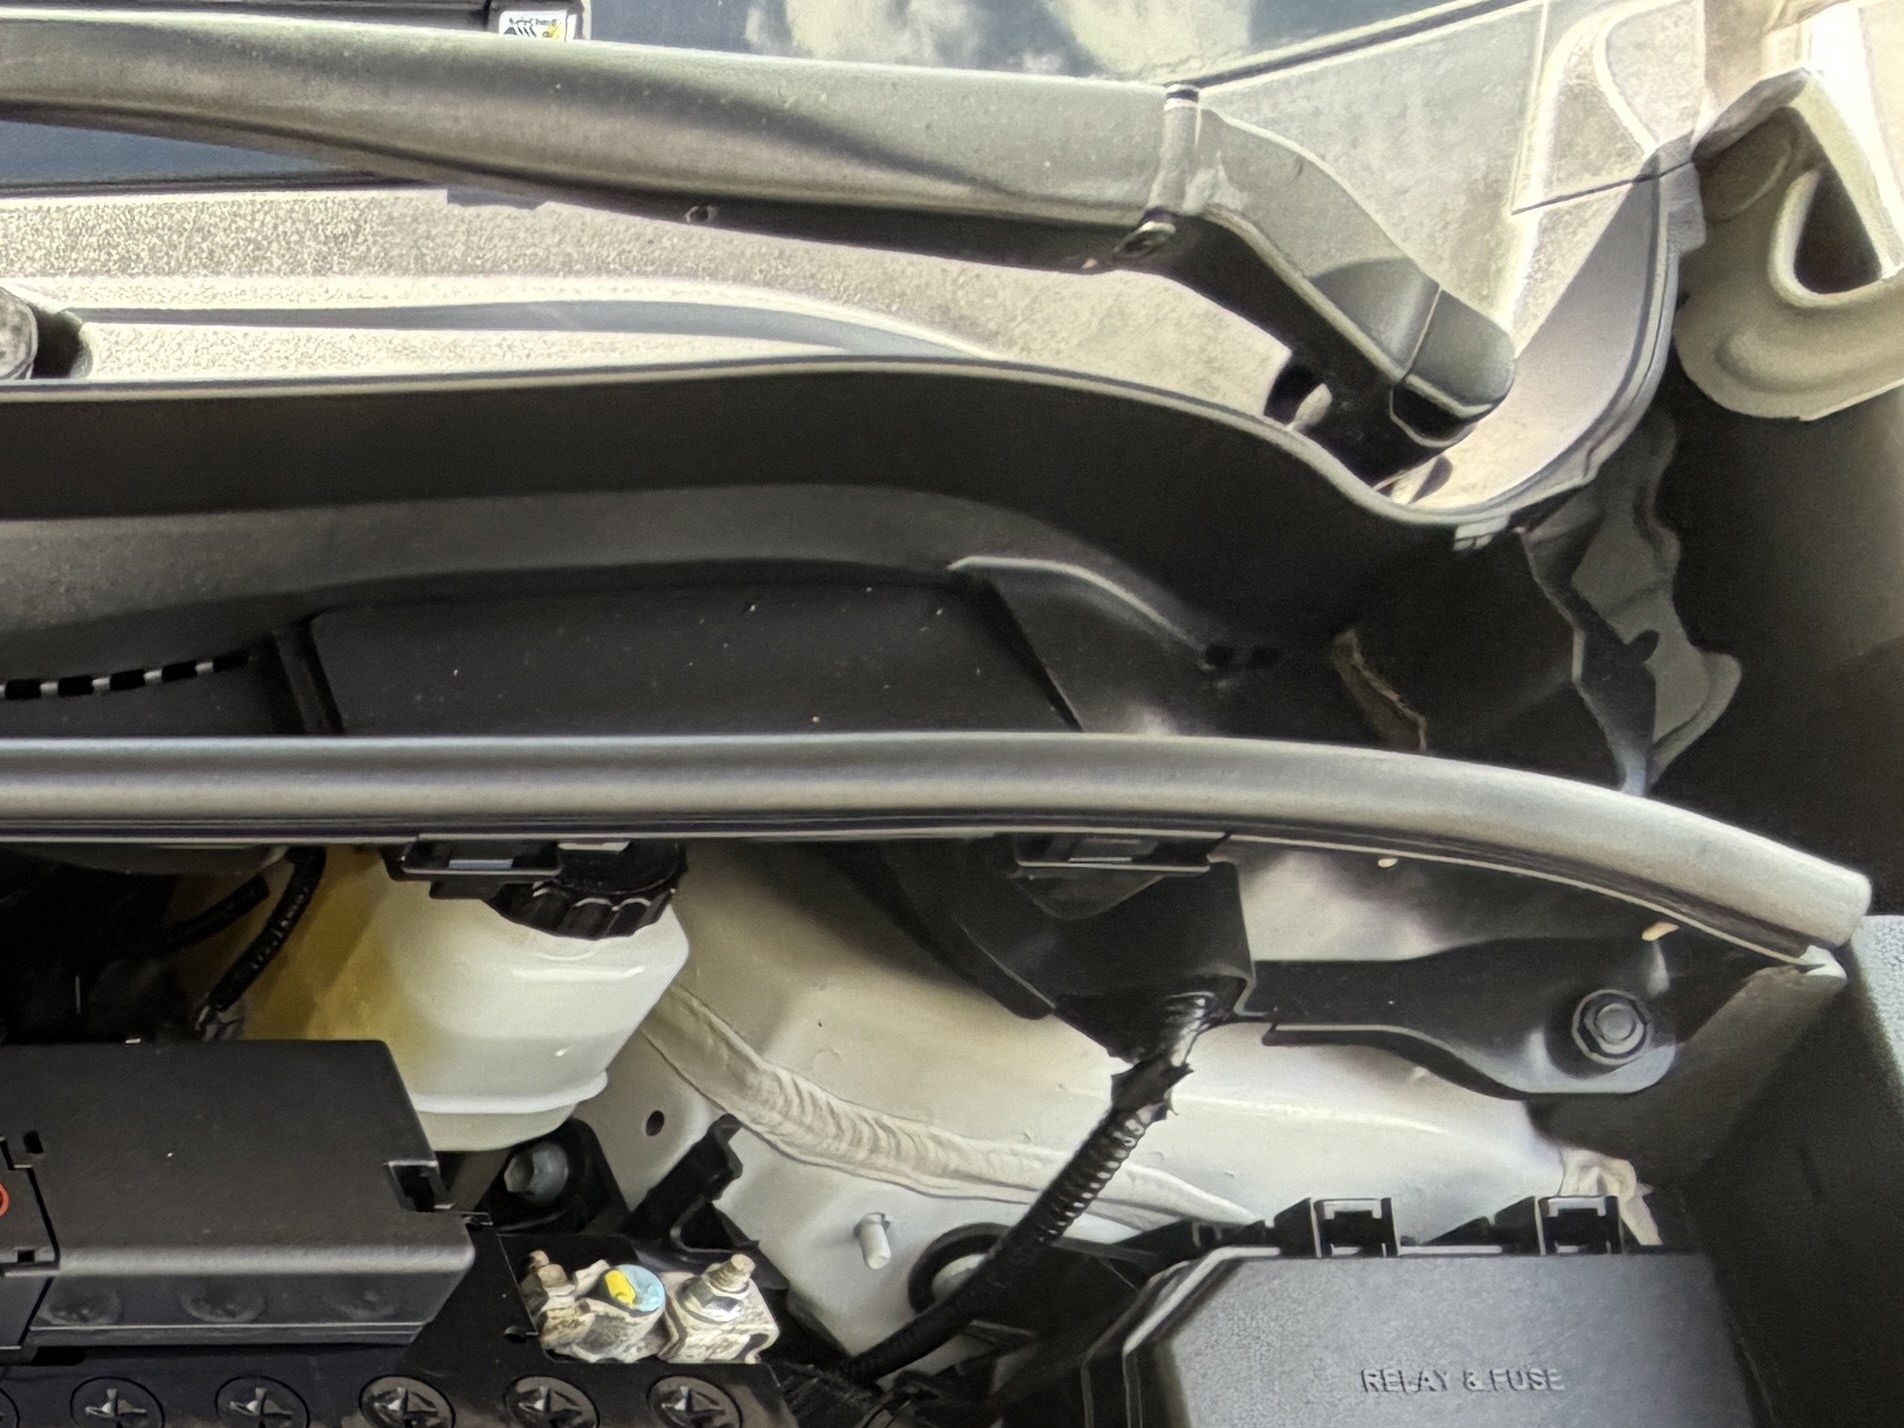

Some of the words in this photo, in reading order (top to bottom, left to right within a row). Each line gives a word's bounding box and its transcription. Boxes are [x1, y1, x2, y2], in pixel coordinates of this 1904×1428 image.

[1361, 1368, 1450, 1393] RELAY
[1463, 1369, 1487, 1392] &
[1489, 1368, 1565, 1392] FUSE
